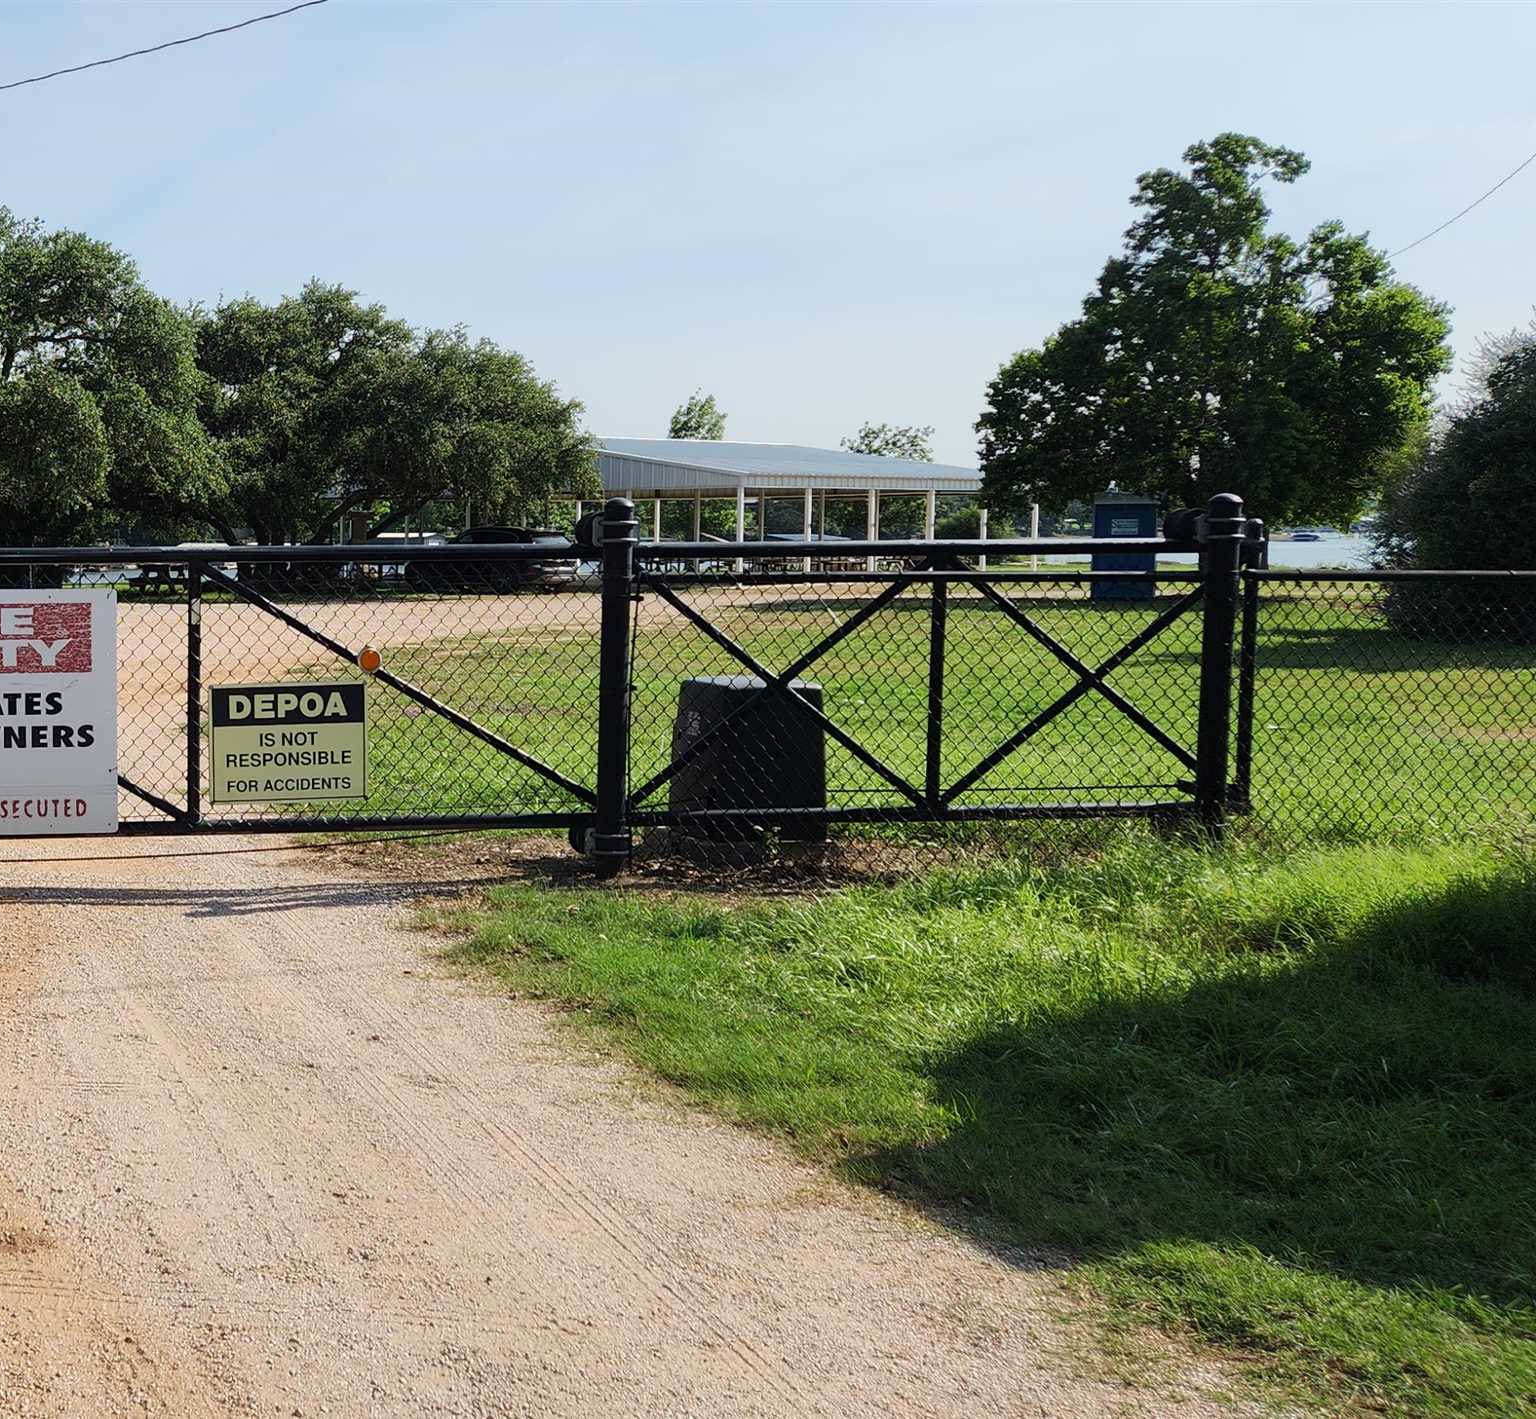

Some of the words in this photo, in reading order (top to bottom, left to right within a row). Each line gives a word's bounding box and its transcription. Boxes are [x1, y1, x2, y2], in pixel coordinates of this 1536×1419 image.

[228, 692, 347, 720] DEPOA
[260, 733, 275, 747] IS
[282, 732, 318, 746] NOT
[226, 750, 351, 768] RESPONSIBLE
[227, 780, 258, 792] FOR
[264, 777, 351, 792] ACCIDENTS
